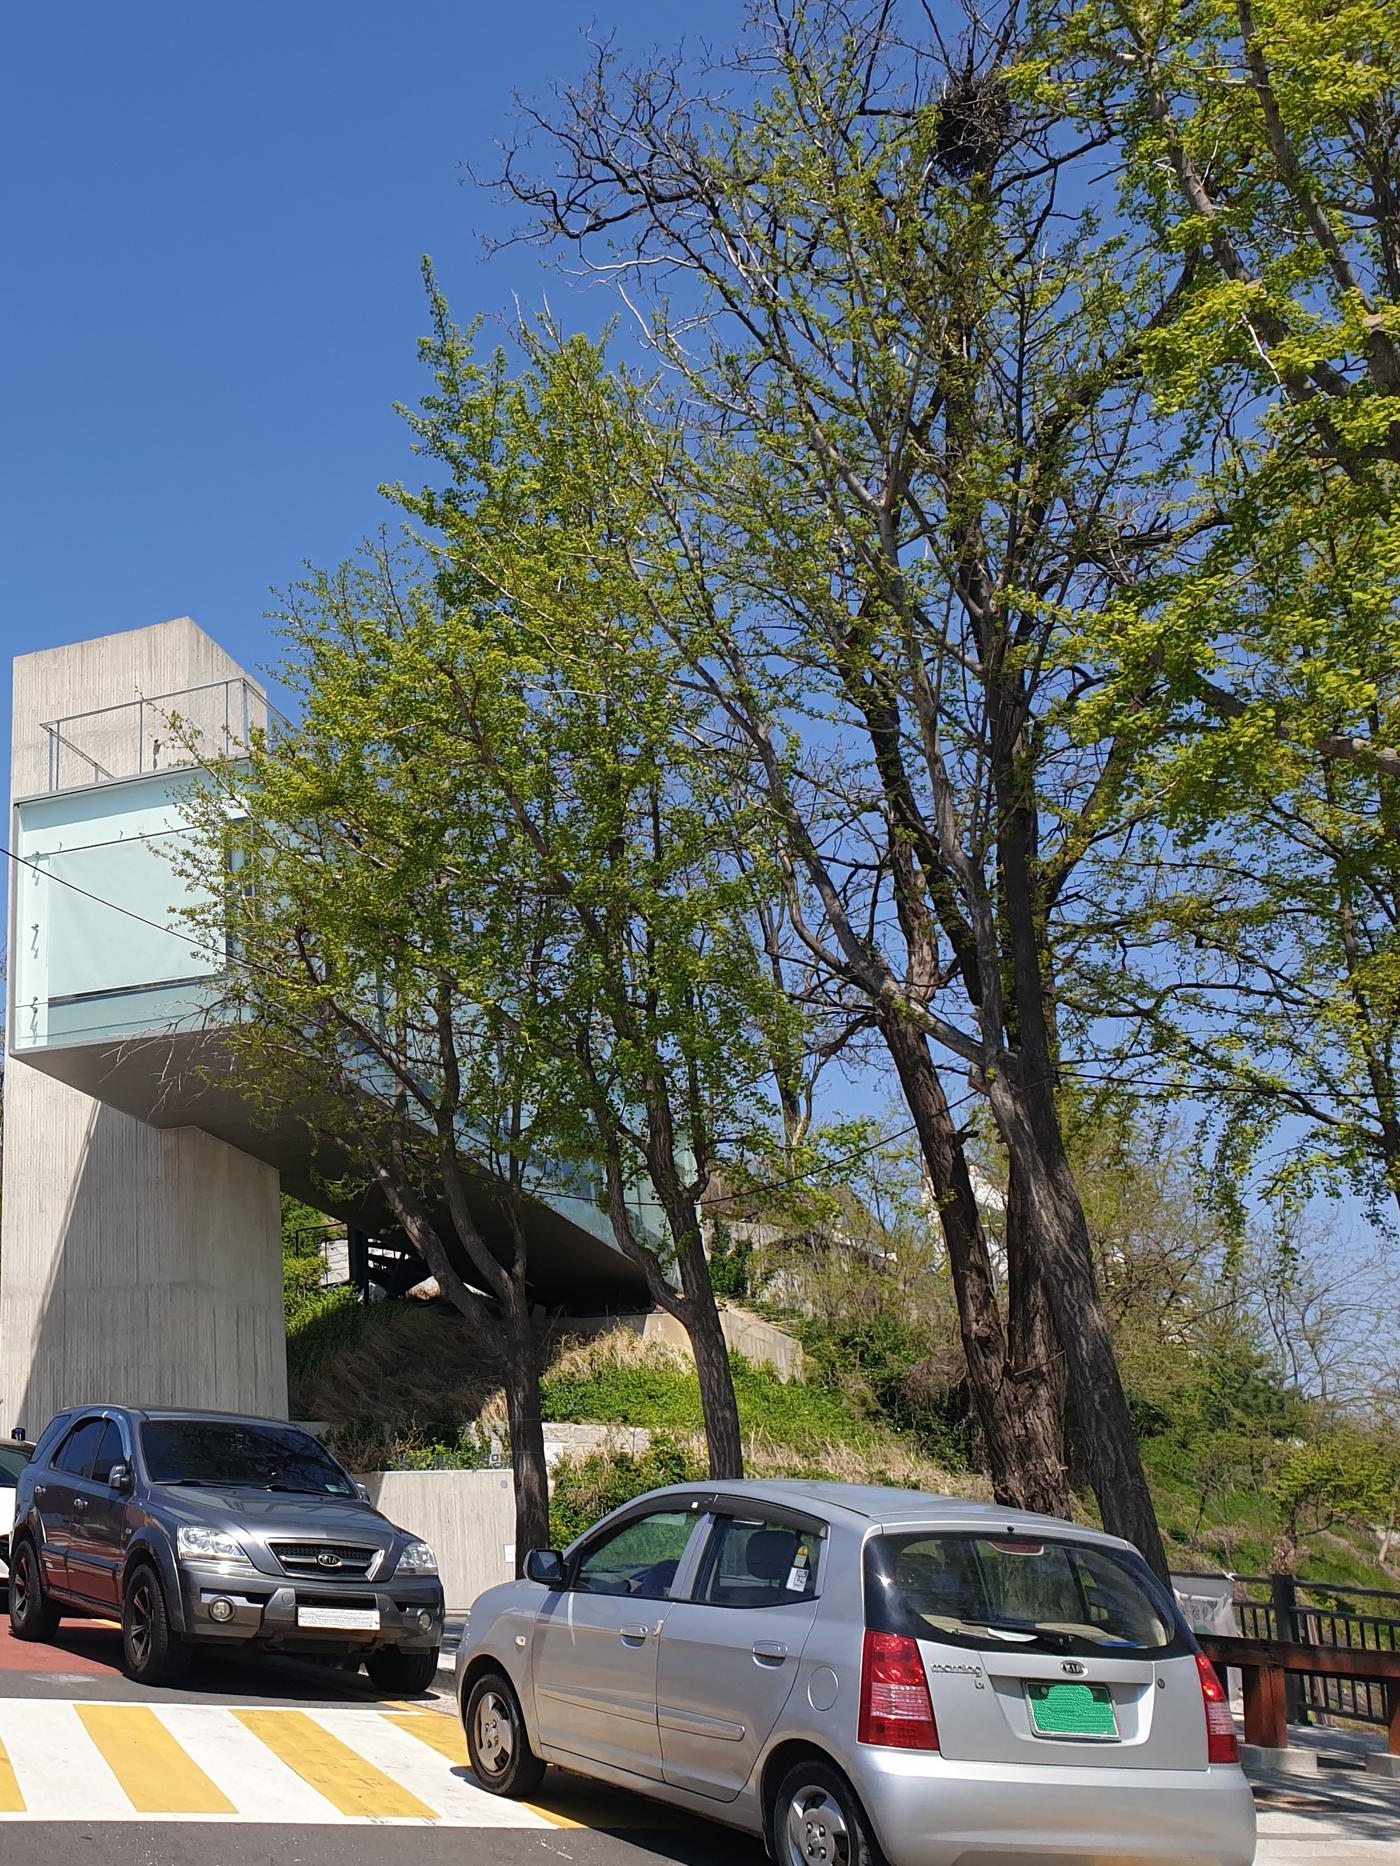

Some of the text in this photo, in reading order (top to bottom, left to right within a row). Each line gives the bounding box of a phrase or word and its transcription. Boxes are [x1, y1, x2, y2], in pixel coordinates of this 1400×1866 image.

[321, 1556, 338, 1564] KIA
[931, 1663, 983, 1678] morning
[1065, 1664, 1083, 1673] KIA
